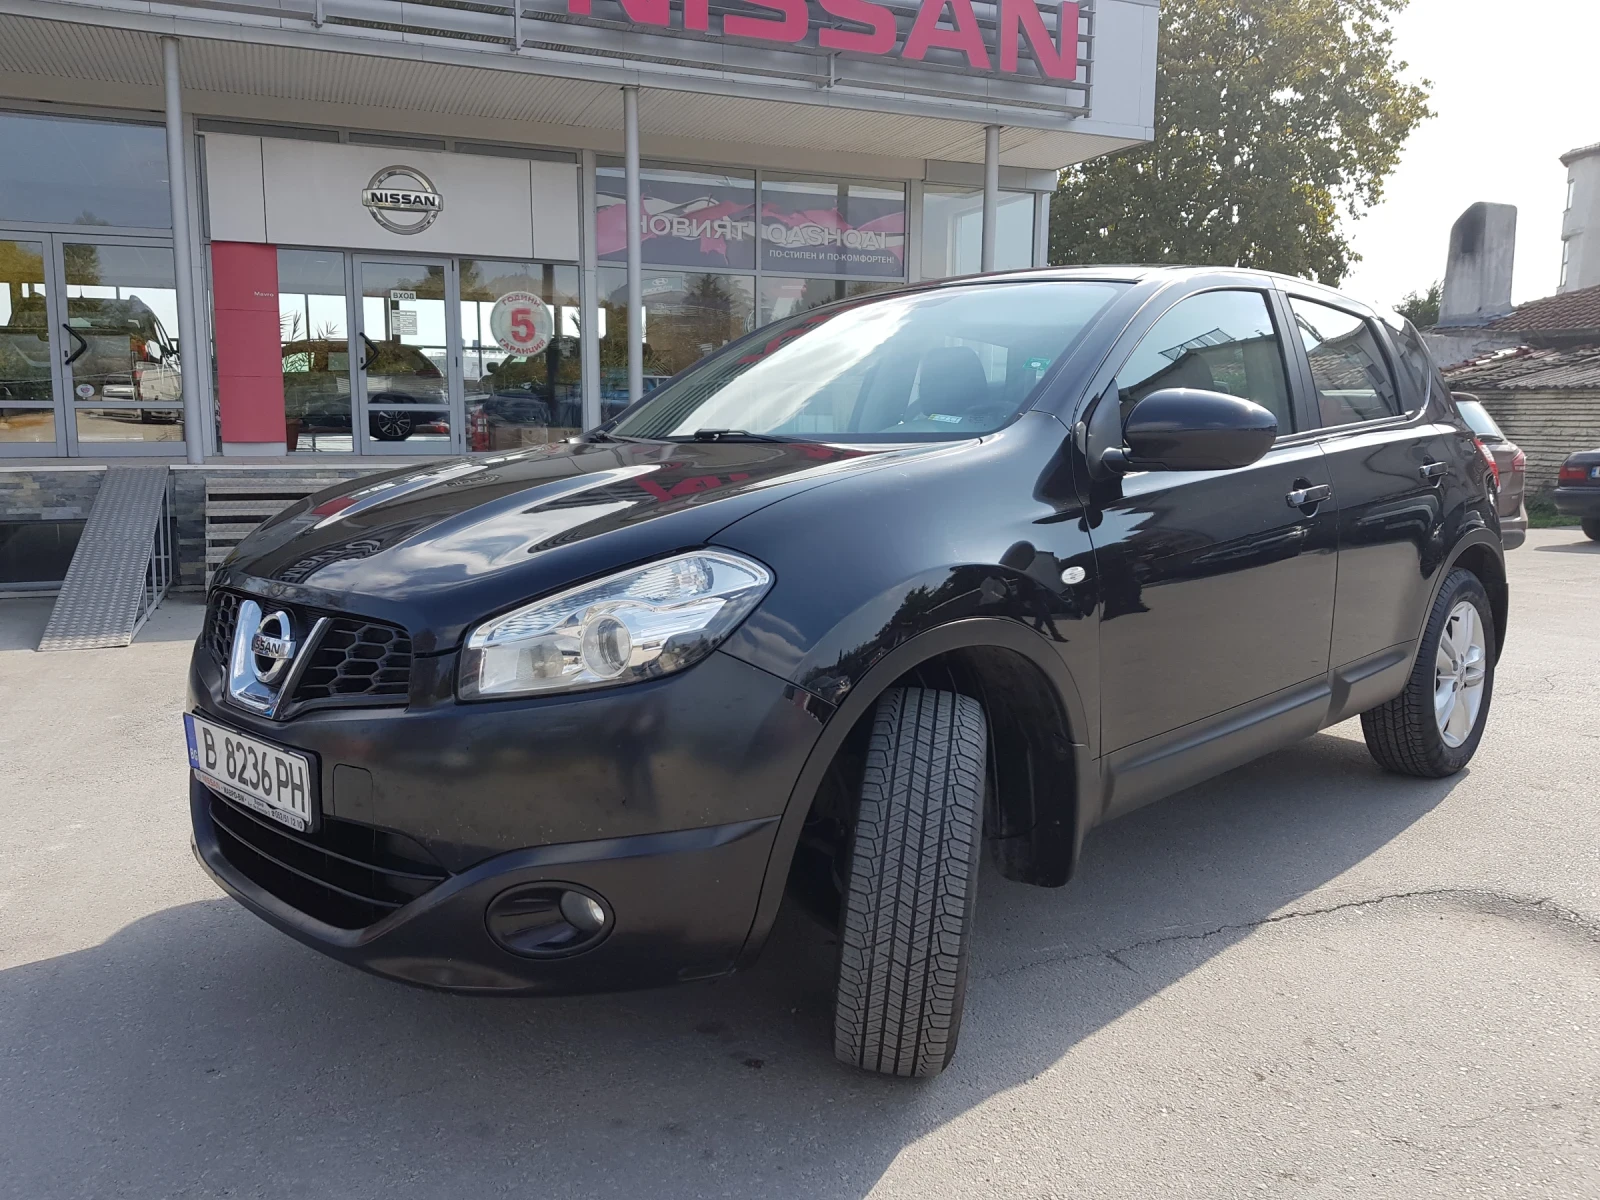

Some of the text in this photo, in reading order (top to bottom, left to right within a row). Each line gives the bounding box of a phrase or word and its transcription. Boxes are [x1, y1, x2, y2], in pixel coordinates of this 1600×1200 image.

[370, 192, 436, 207] NISSAN
[767, 223, 886, 251] QASHQAI
[769, 249, 817, 260] ПО-СТИЛЕН
[818, 252, 825, 260] И
[392, 292, 415, 300] ВХОД
[502, 294, 541, 308] ГОДИНИ
[511, 308, 535, 343] 5
[499, 338, 546, 355] ГАРАНЦИЯ
[190, 747, 199, 761] BG
[202, 726, 217, 771] B
